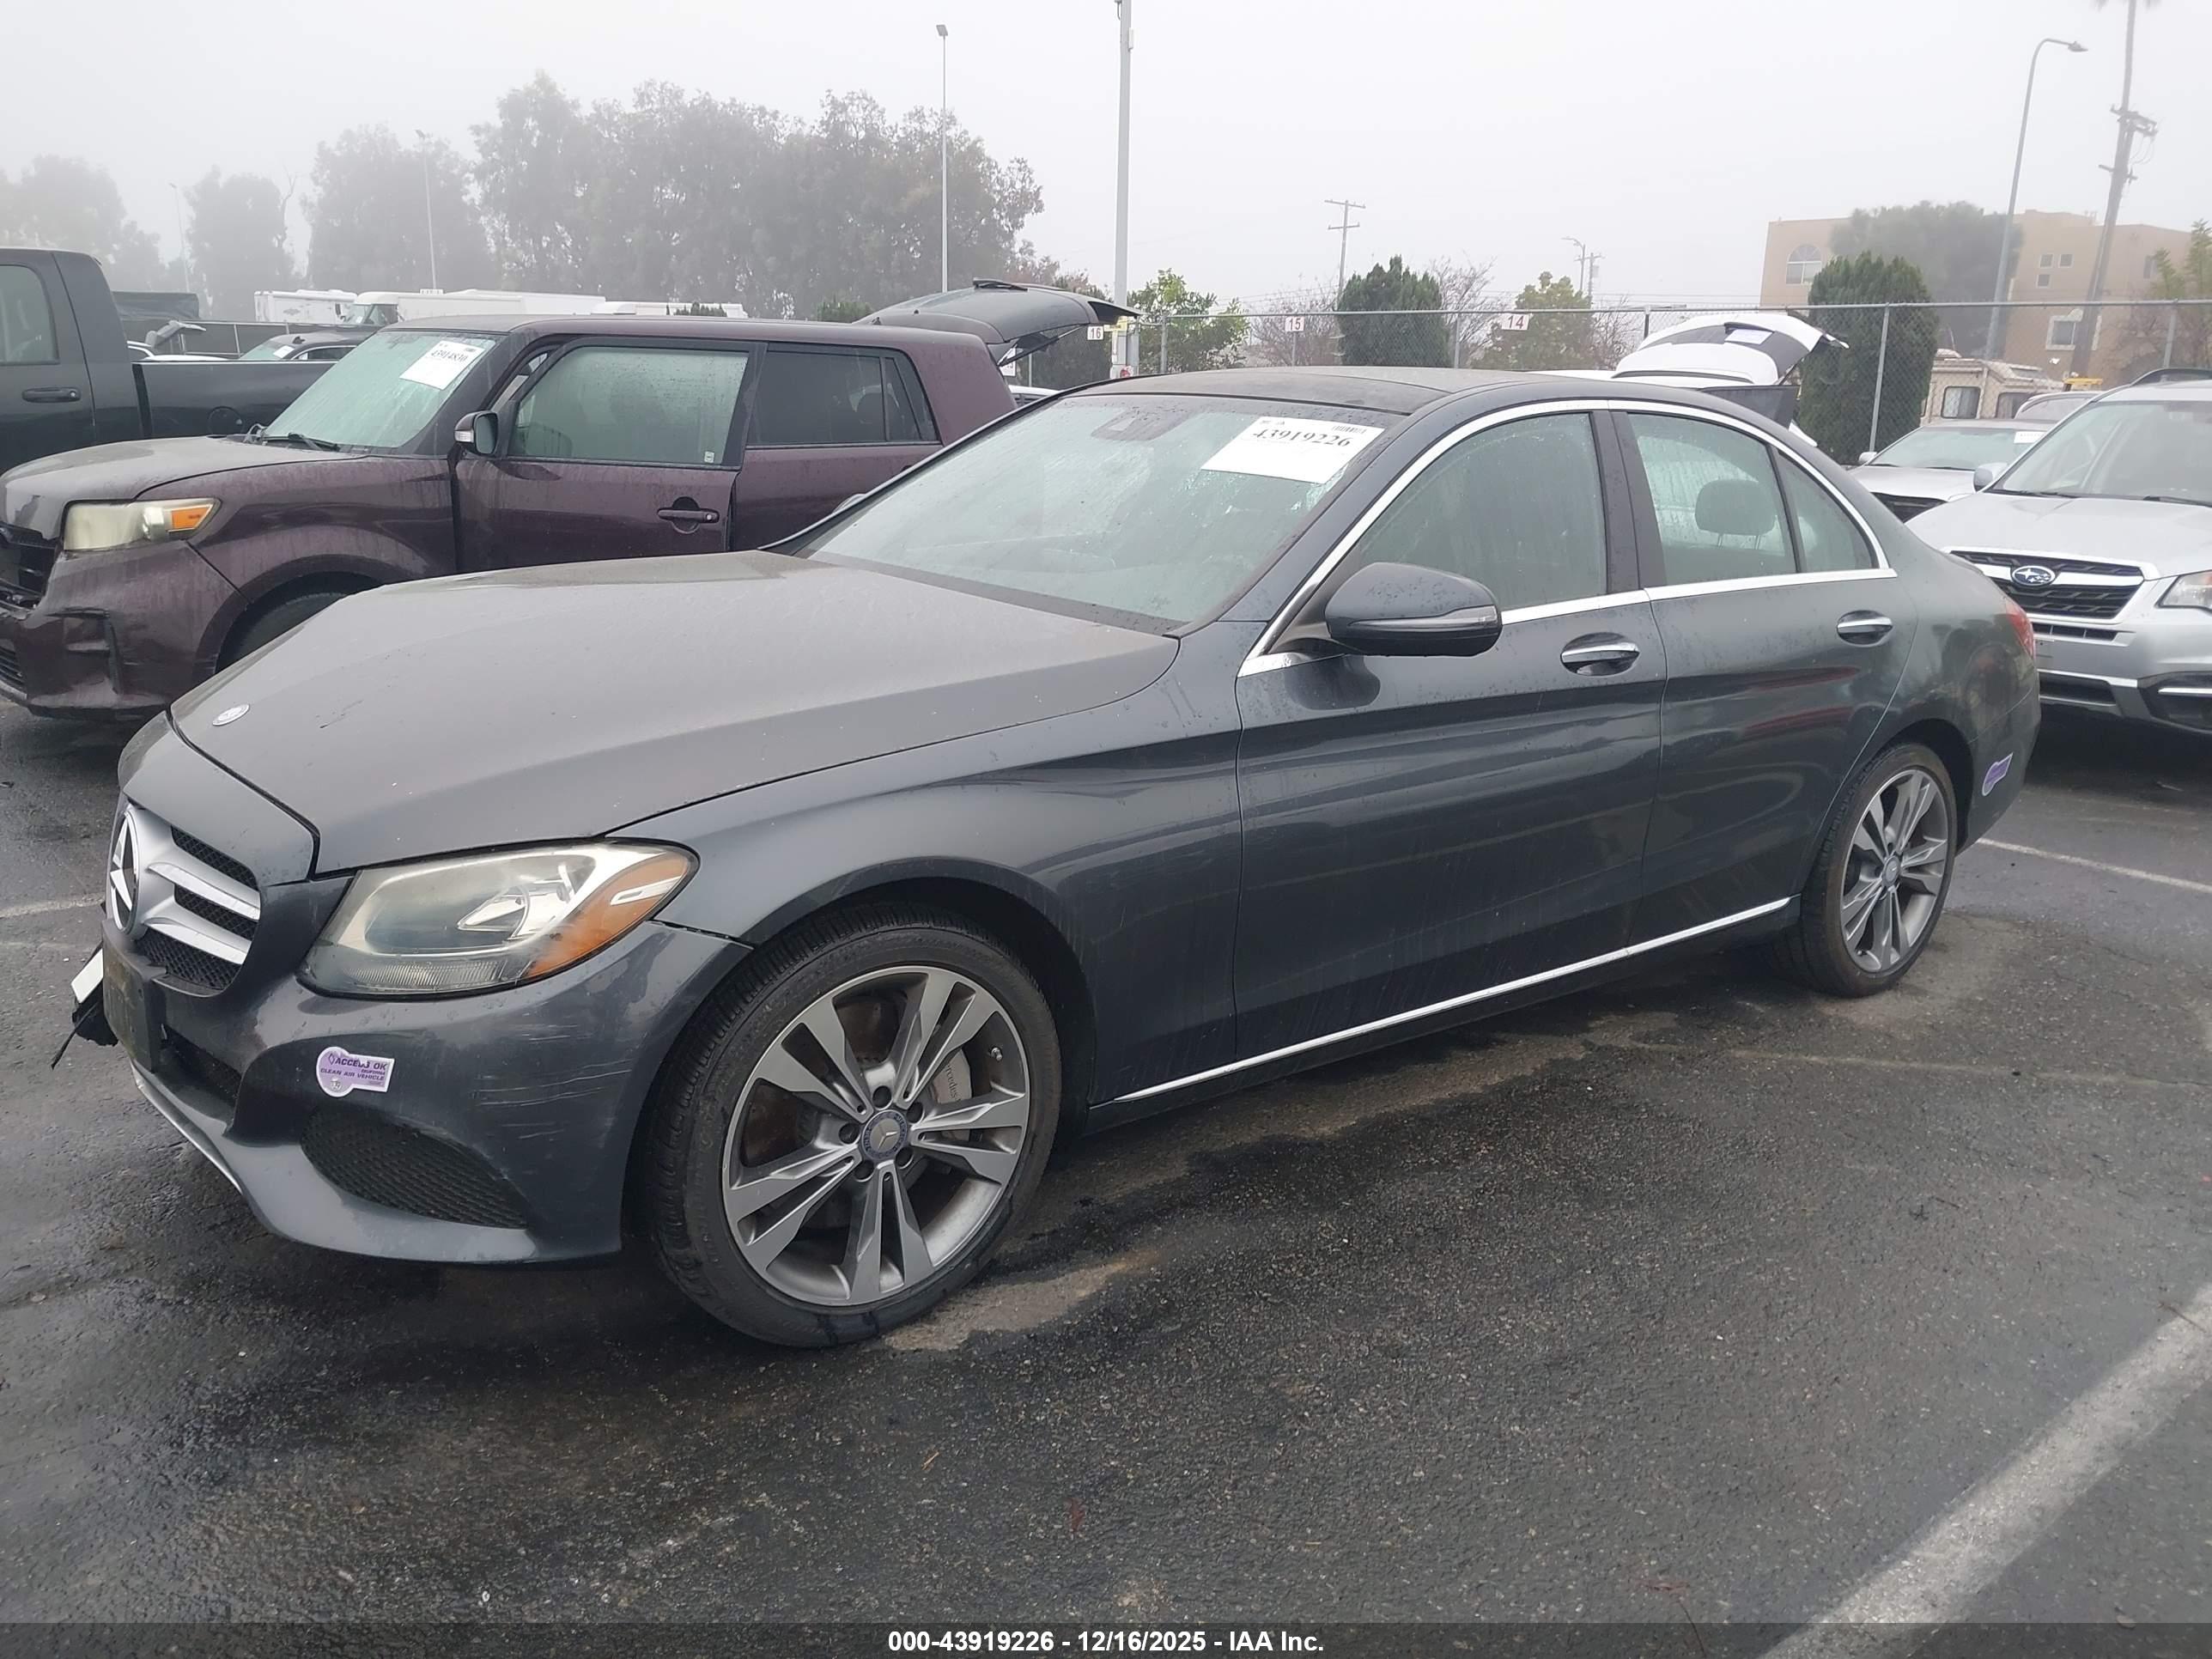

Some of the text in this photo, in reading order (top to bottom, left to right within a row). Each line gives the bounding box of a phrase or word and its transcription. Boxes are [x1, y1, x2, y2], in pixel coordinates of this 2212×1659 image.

[1290, 318, 1301, 331] 15
[1508, 315, 1524, 330] 14
[1091, 327, 1102, 339] 16
[1253, 428, 1353, 447] 43919226
[320, 1067, 342, 1076] CLEAN
[374, 1062, 388, 1071] OK
